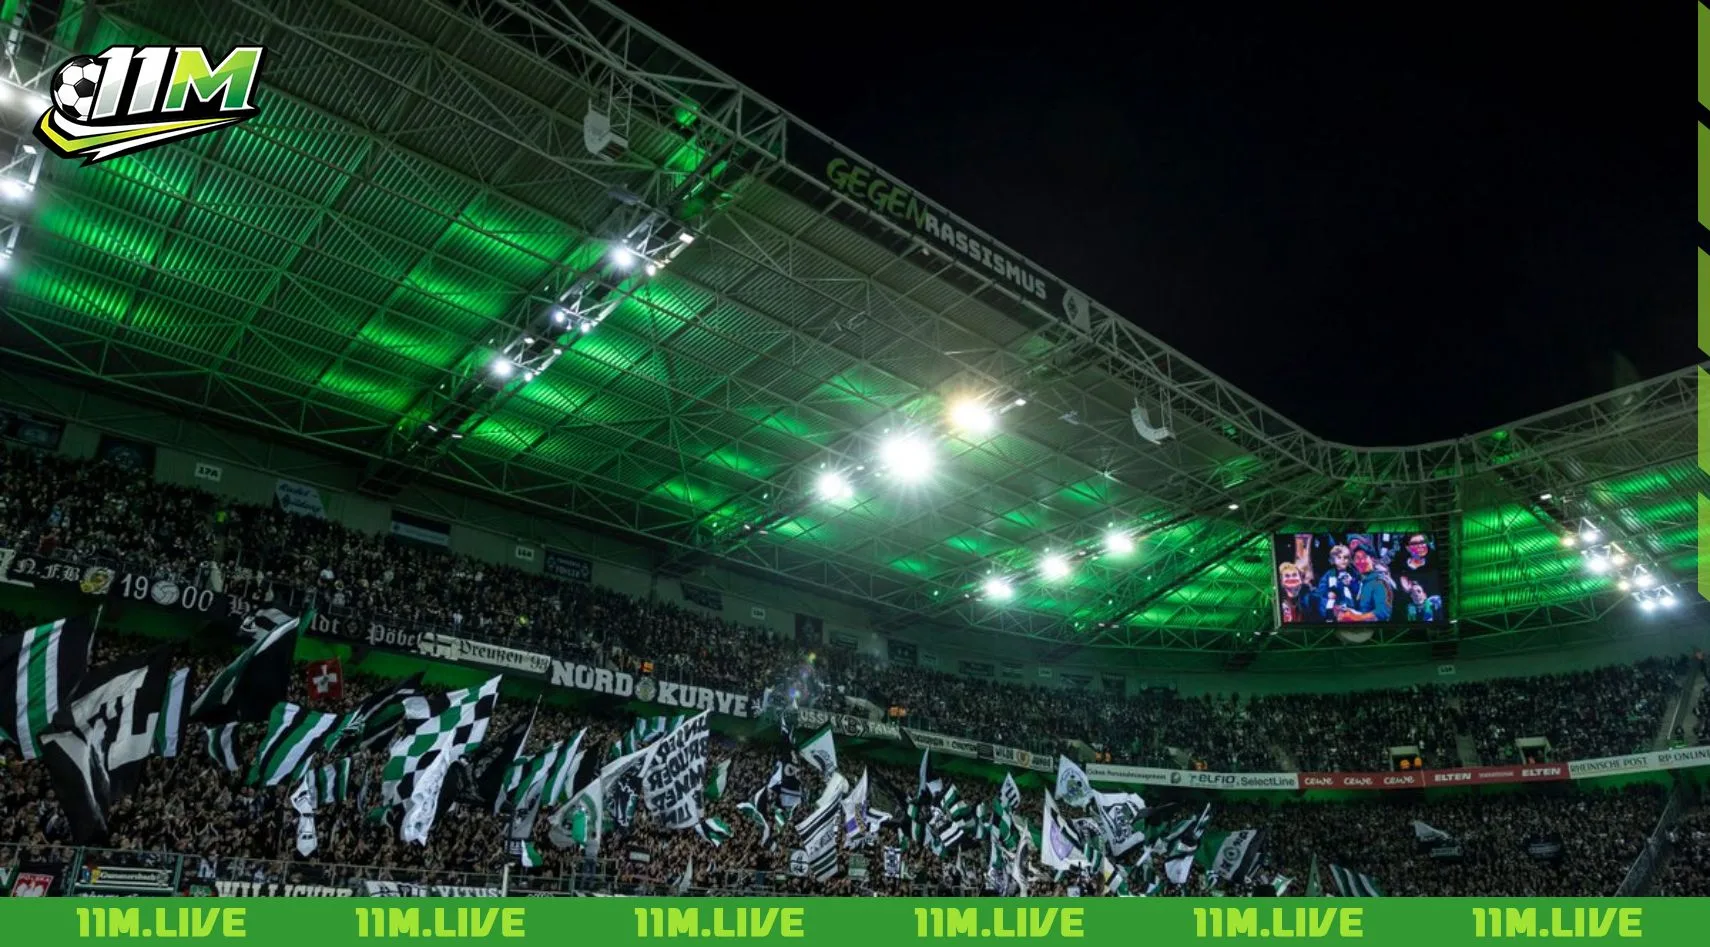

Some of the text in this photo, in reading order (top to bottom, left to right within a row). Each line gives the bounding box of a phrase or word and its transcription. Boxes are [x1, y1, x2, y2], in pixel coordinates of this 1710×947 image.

[825, 158, 1048, 300] GEGEN RASSISMUS
[550, 659, 749, 718] NORD KURVE
[1623, 756, 1648, 767] POST
[1434, 772, 1472, 782] ELTEN
[1521, 767, 1561, 777] ELTEN
